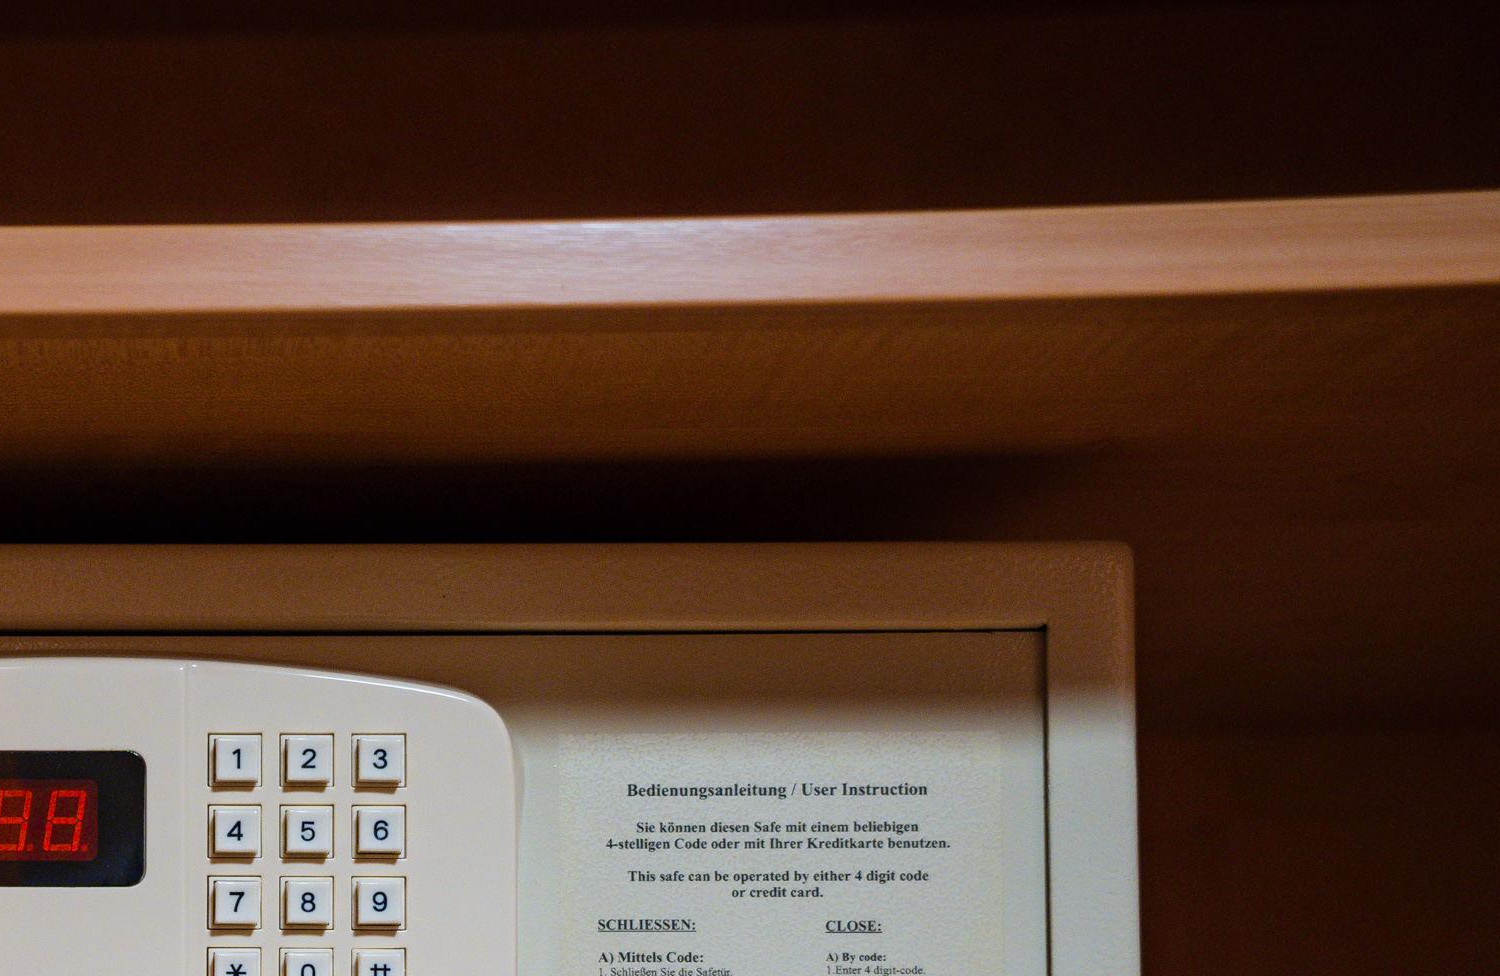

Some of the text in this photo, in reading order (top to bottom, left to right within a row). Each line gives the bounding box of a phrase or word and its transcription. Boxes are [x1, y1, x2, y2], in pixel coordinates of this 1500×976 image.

[232, 749, 387, 769] 1 2 3
[627, 782, 928, 800] Bedienungsanleitung / User Instruction
[227, 820, 389, 841] 4 5 6
[636, 821, 919, 836] Sie können diesen Safe mit einem beliebigen
[606, 837, 950, 852] 4-stelligen Code oder mit Ihrer Kreditkarte benutzen.
[627, 870, 929, 885] This safe can be operated by either 4 digit code
[731, 886, 824, 898] or credit card.
[229, 892, 387, 912] 7 8 9
[597, 919, 696, 932] SCHLIESSEN:
[825, 920, 882, 934] CLOSE:
[598, 951, 704, 964] A) Mittels Code:
[826, 952, 886, 964] A) By code:
[610, 967, 658, 976] Schließen
[660, 967, 676, 976] Sie
[678, 967, 694, 976] die
[696, 967, 732, 976] Safetür.
[864, 966, 871, 974] 4
